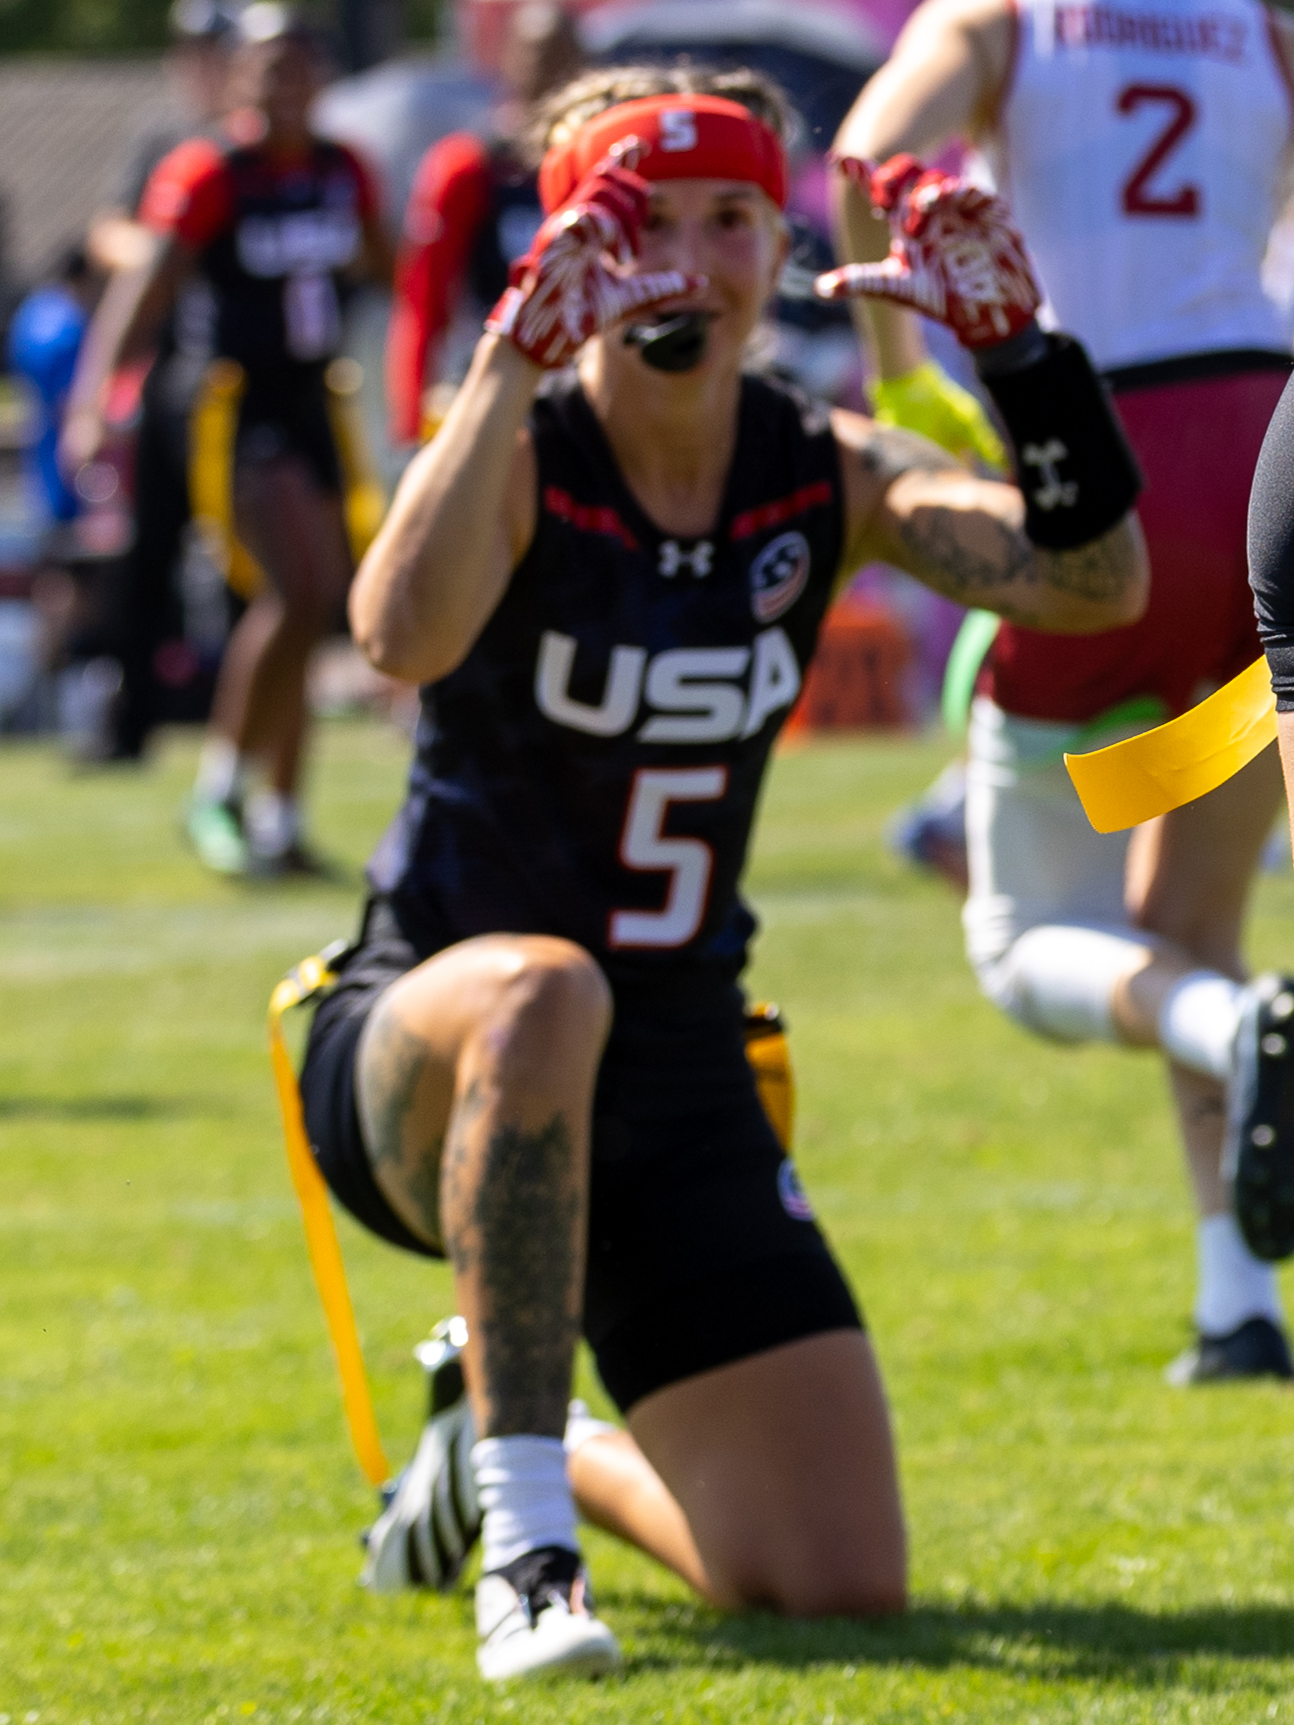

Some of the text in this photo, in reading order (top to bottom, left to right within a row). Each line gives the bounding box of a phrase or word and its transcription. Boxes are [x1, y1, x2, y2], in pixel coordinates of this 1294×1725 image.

[657, 108, 699, 154] 5
[1116, 83, 1202, 219] 2
[534, 626, 801, 743] USA
[606, 765, 730, 952] 5
